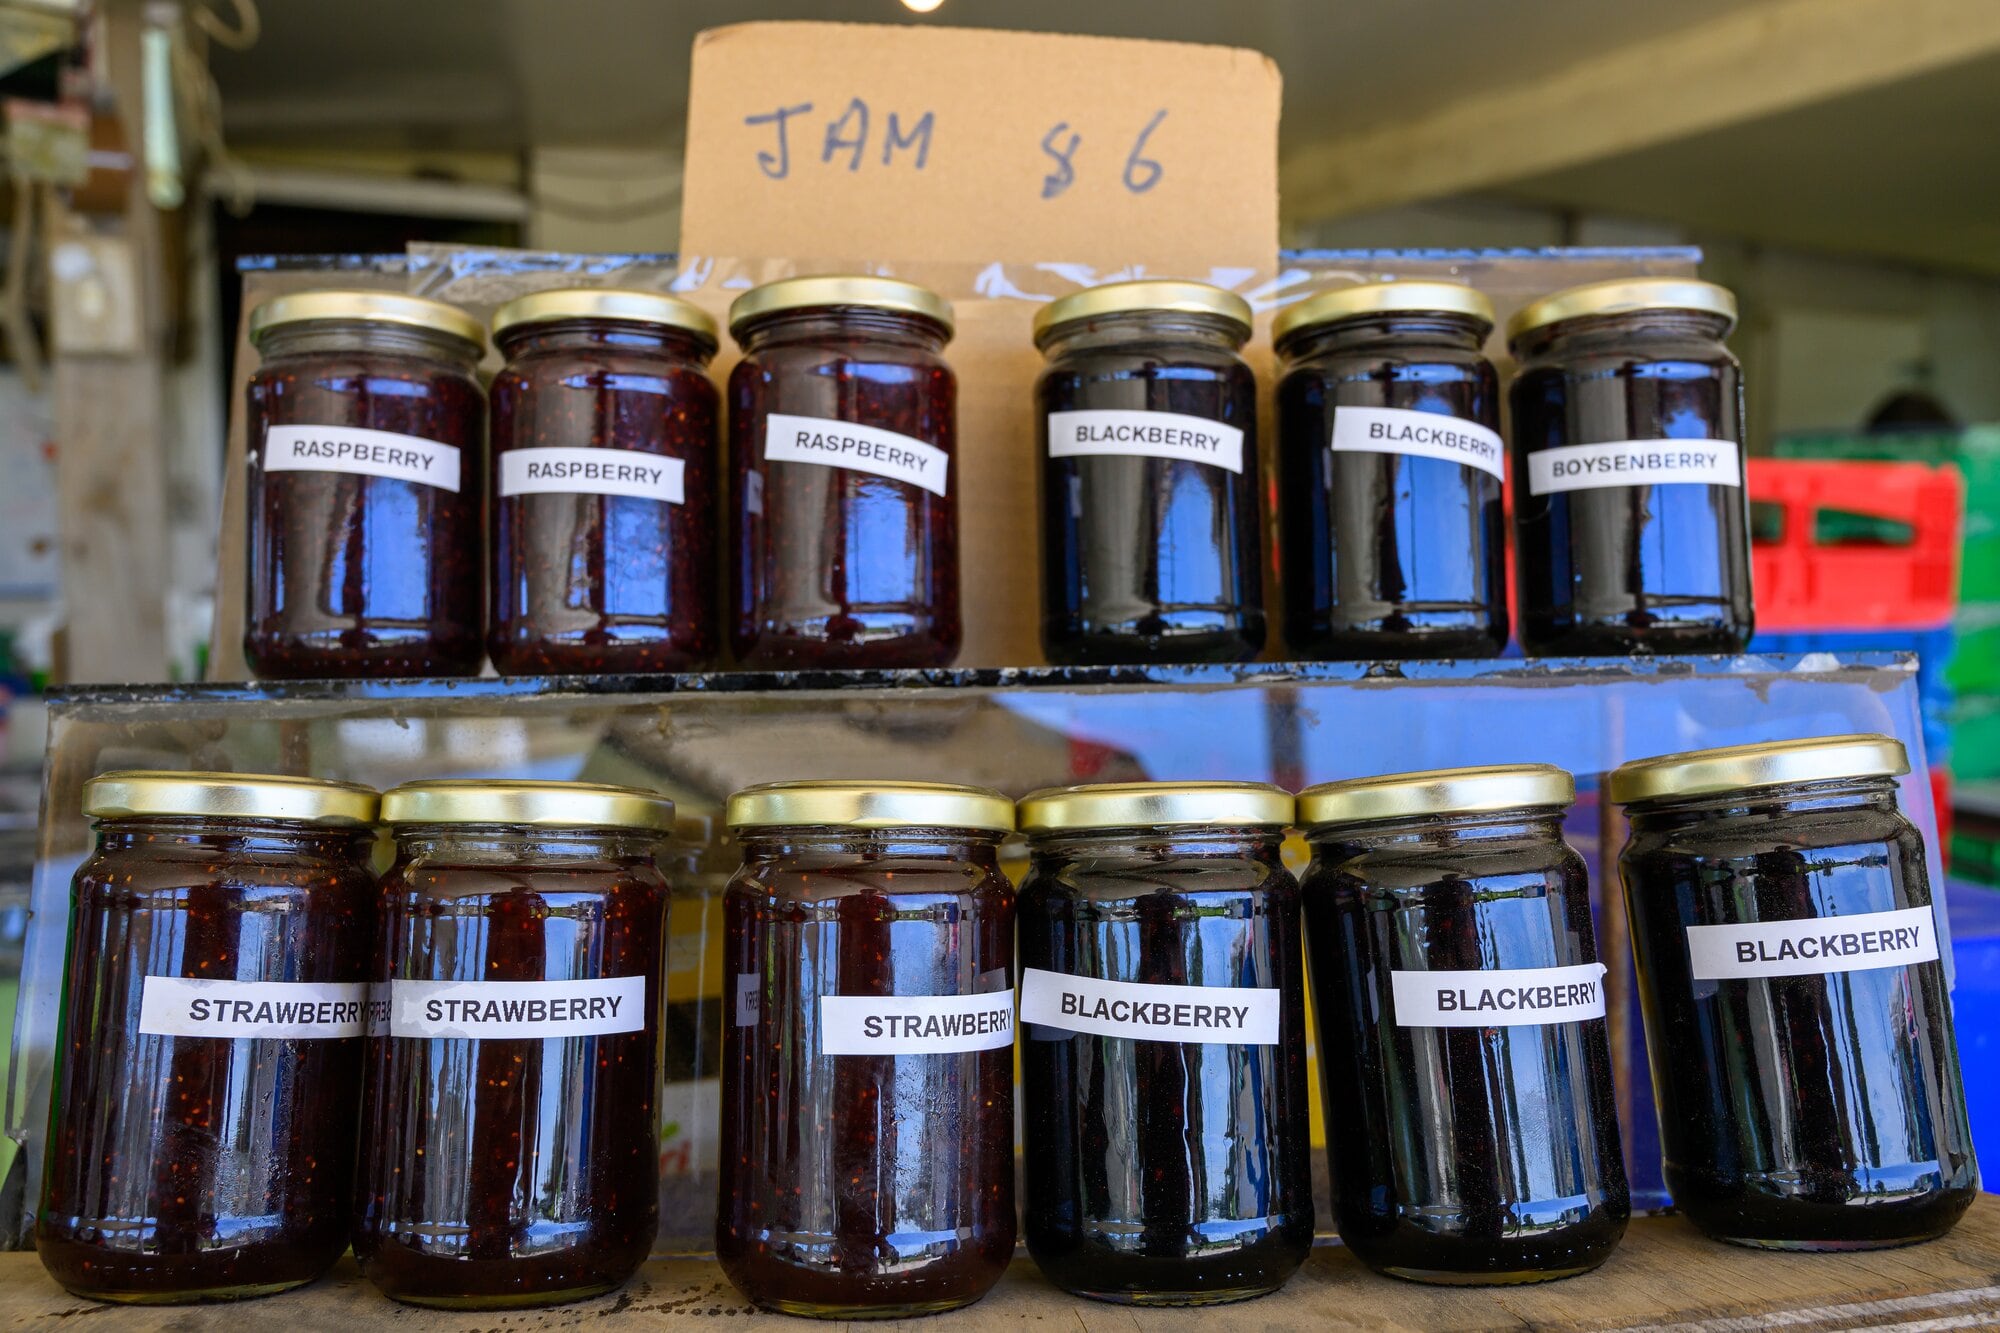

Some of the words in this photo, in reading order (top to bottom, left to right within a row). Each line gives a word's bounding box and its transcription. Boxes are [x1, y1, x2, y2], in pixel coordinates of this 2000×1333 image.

[745, 97, 935, 180] JAM
[795, 430, 929, 473] RASPBERRY
[1075, 424, 1221, 453] BLACKBERRY
[1368, 422, 1496, 460] BLACKBERRY
[293, 440, 434, 471] RASPBERRY
[1552, 453, 1719, 478] BOYSENBERRY
[527, 462, 663, 486] RASPBERRY
[1735, 926, 1919, 963] BLACKBERRY
[189, 998, 366, 1024] STRAWBERRY
[425, 996, 623, 1023] STRAWBERRY
[1061, 992, 1249, 1028] BLACKBERRY
[1437, 981, 1596, 1012] BLACKBERRY
[863, 1008, 1012, 1038] STRAWBERRY
